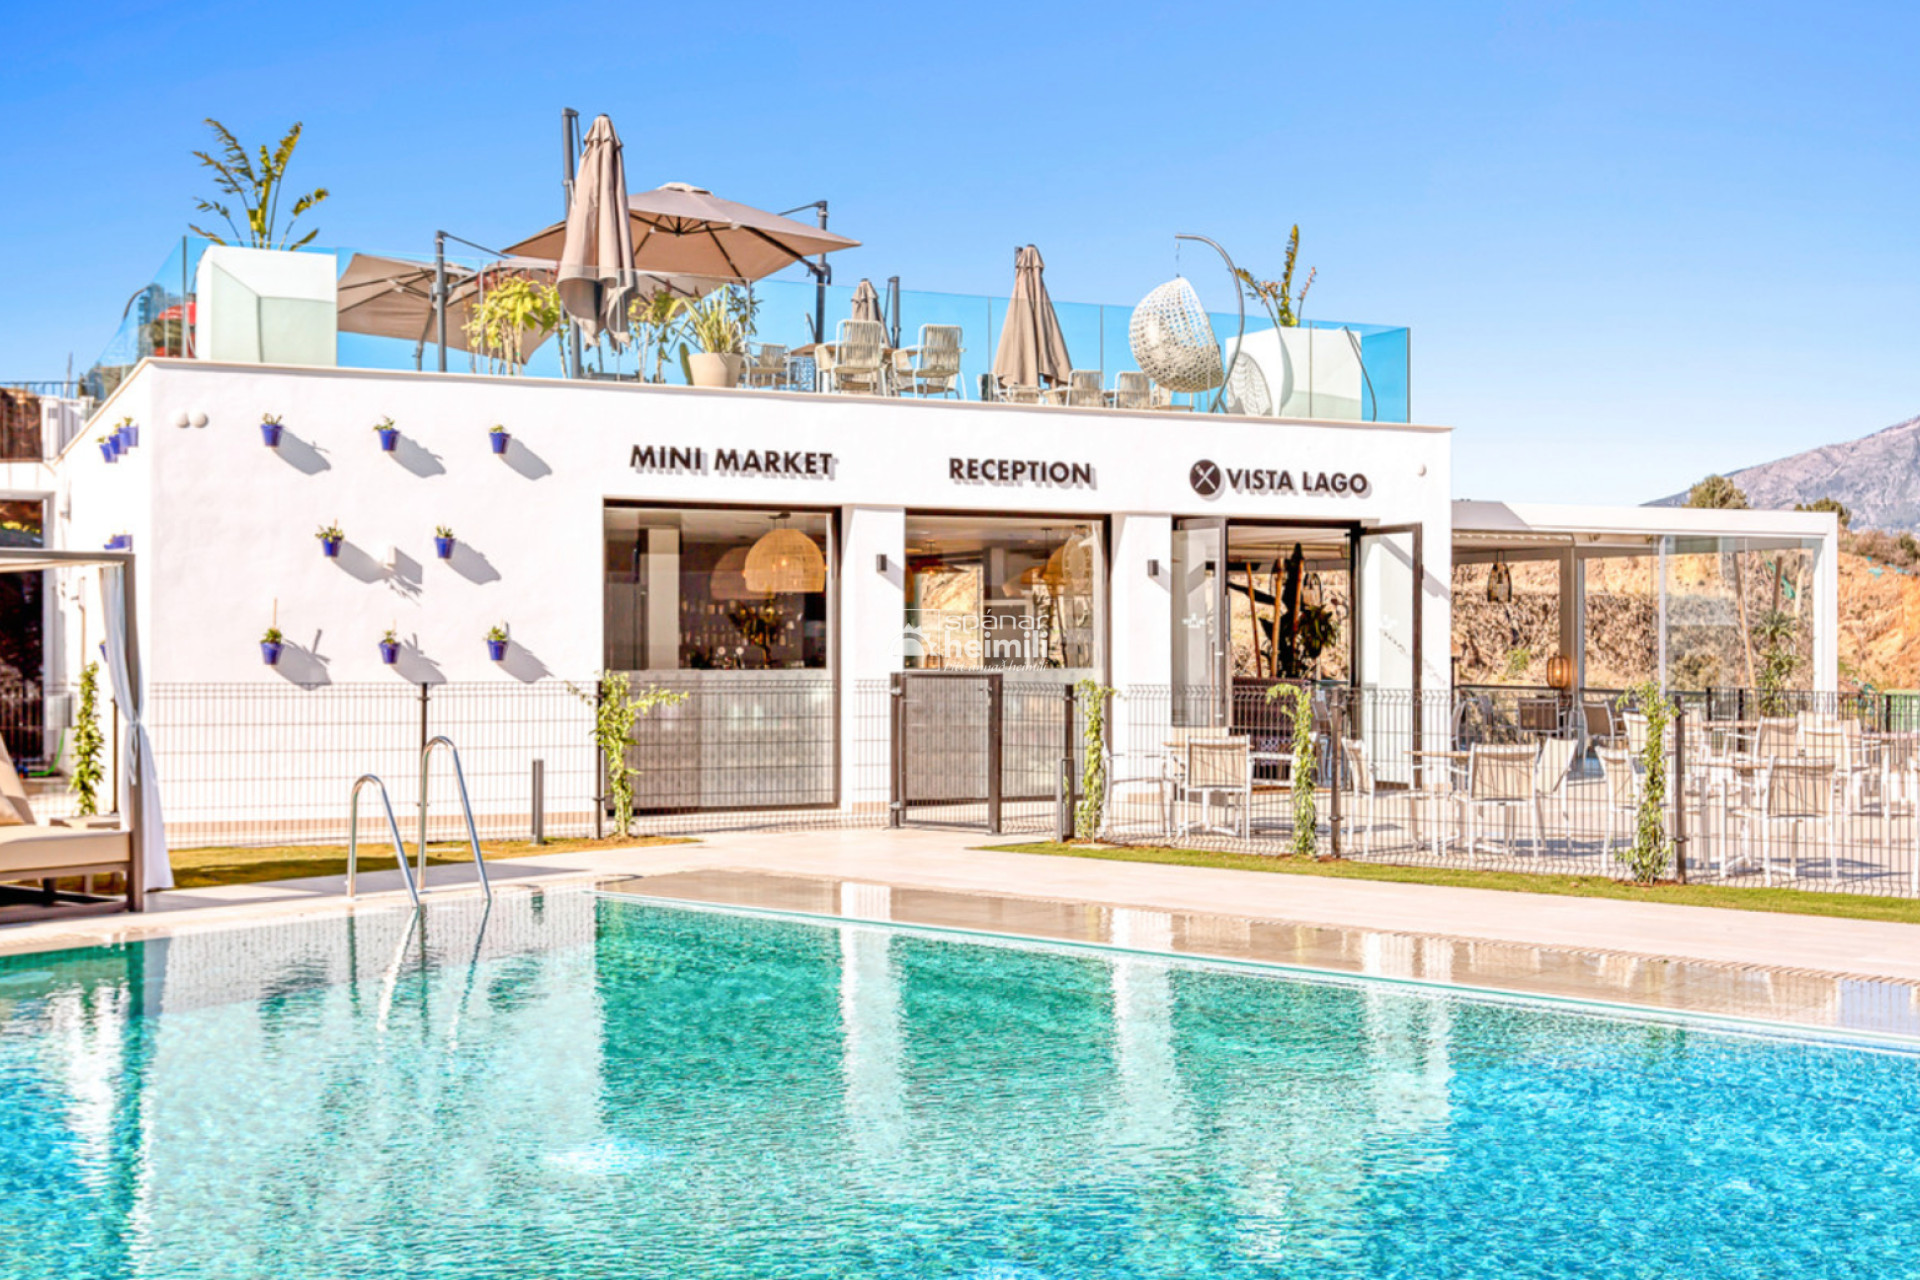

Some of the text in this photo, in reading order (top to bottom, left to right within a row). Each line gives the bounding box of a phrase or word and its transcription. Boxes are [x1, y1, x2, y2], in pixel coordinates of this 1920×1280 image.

[630, 445, 832, 475] MINI MARKET
[950, 458, 1092, 485] RECEPTION
[1227, 469, 1367, 494] VISTA LAGO
